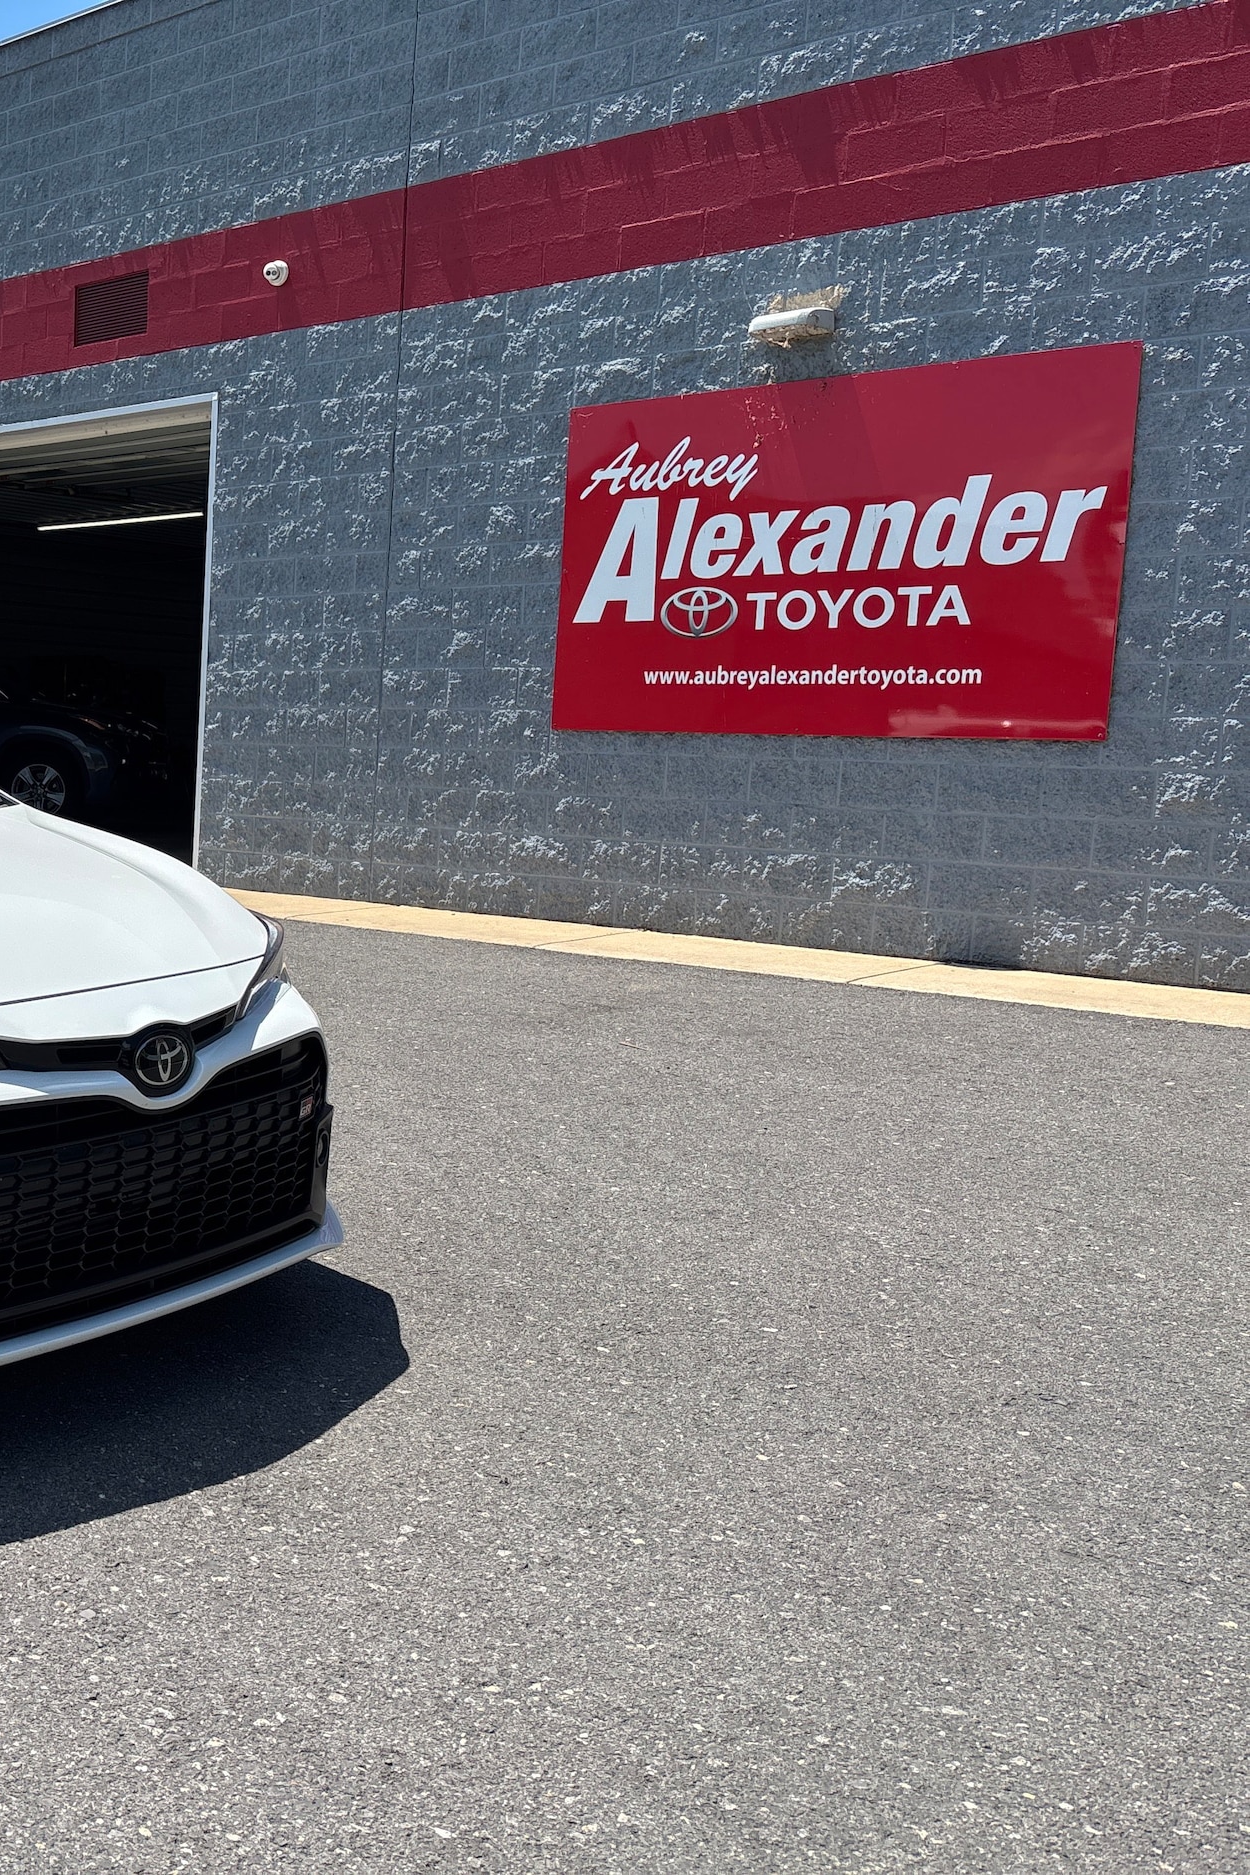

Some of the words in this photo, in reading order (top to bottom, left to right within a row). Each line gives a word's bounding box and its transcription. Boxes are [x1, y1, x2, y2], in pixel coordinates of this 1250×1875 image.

[580, 435, 759, 501] Aubrey
[572, 474, 1108, 624] Alexander
[746, 585, 971, 631] TOYOTA
[644, 665, 982, 690] www.aubreyalexandertoyota.com
